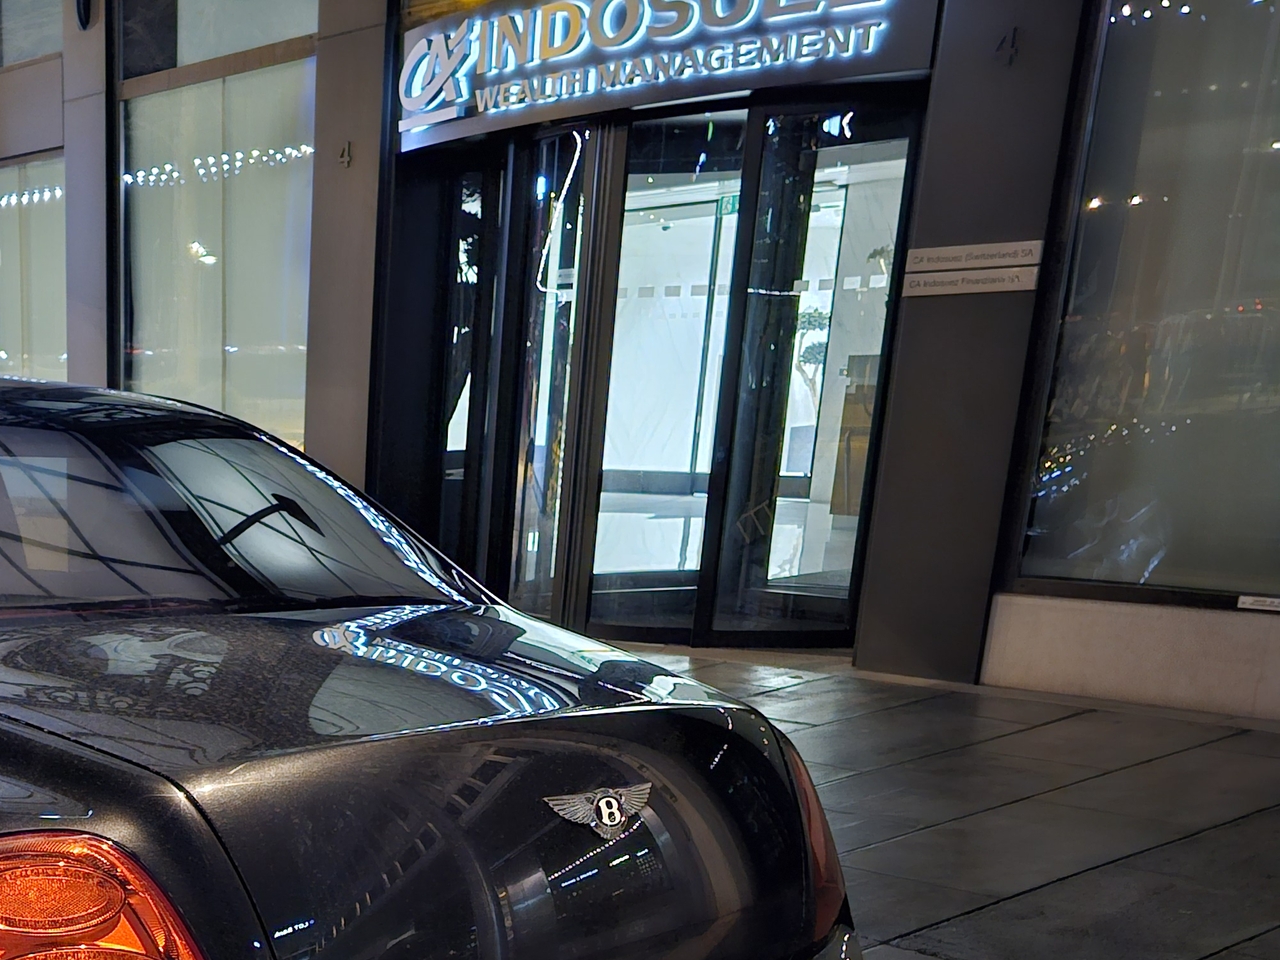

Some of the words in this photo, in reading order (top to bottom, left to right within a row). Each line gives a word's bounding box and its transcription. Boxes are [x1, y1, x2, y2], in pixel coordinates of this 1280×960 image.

[475, 67, 593, 114] WEALTH
[597, 21, 886, 91] MANAGEMENT
[339, 140, 352, 169] 4
[598, 797, 622, 826] B
